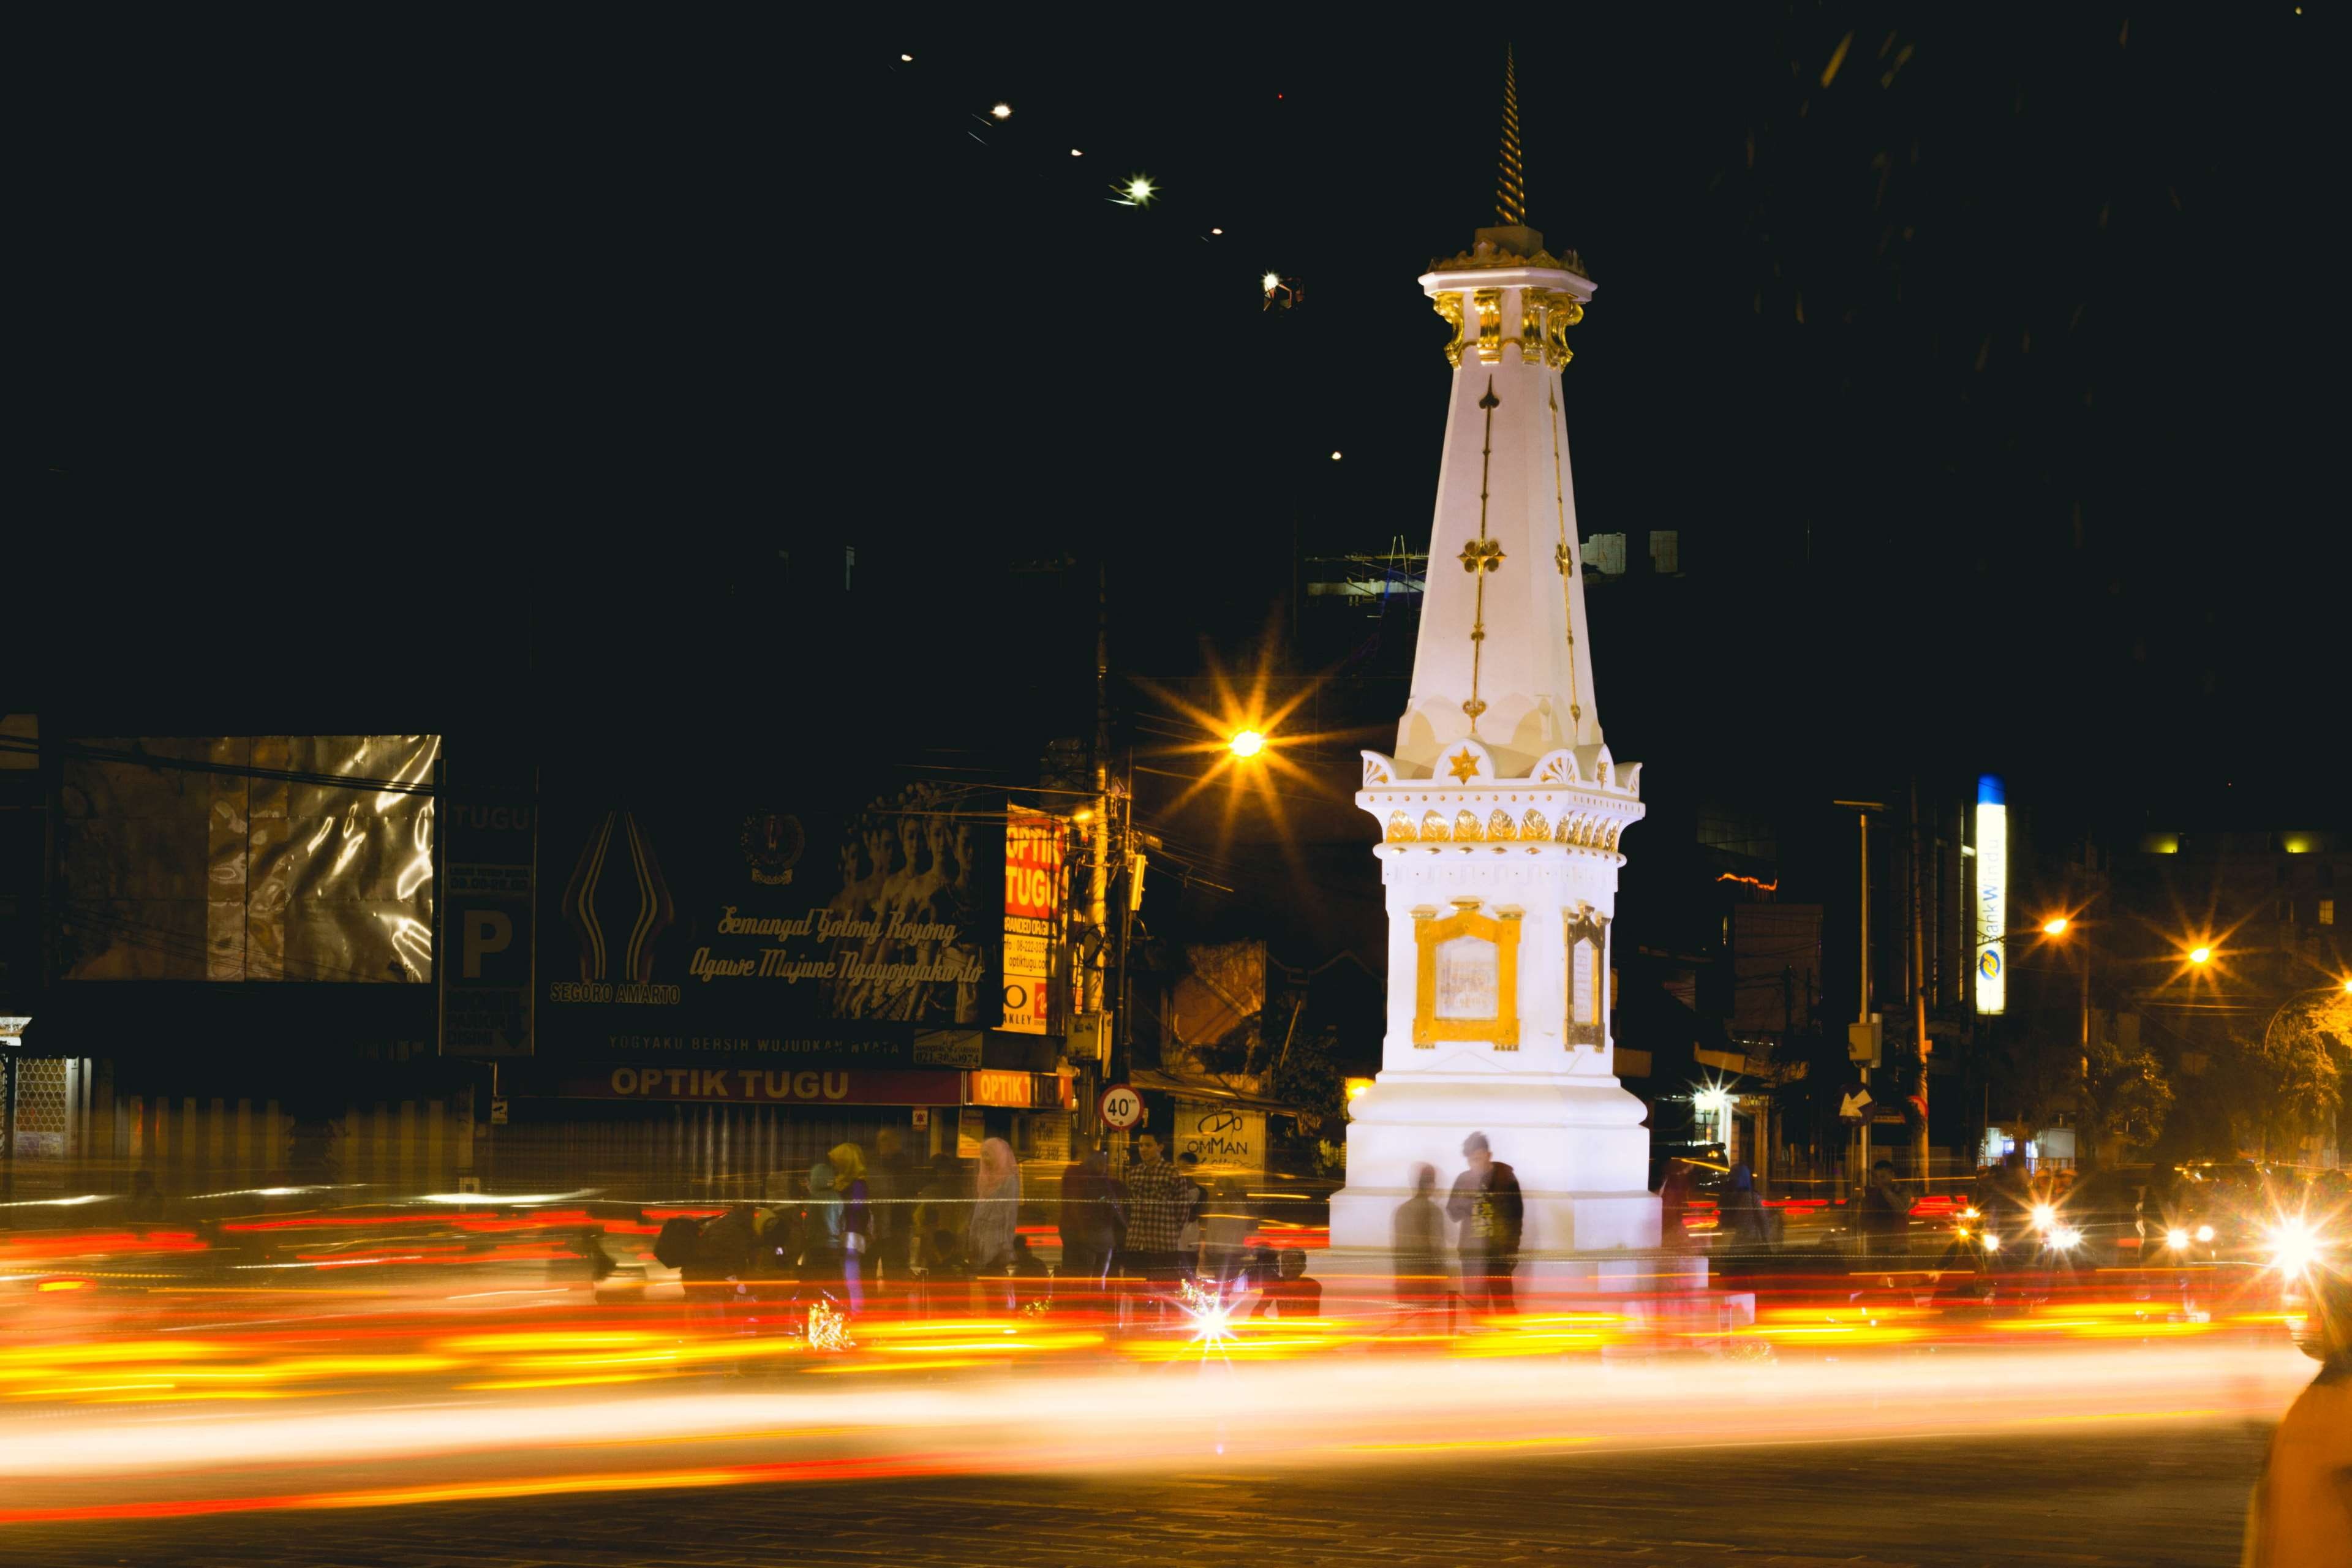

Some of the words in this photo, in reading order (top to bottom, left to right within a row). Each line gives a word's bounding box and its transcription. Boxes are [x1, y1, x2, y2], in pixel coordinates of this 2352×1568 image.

[453, 805, 529, 829] TUGU
[1006, 825, 1061, 864] OPTIK
[1006, 866, 1059, 909] TUGU
[717, 906, 813, 942] Semangat
[884, 911, 957, 947] Royong
[462, 910, 513, 978] P
[690, 947, 755, 982] Agawe
[759, 949, 836, 984] Majune
[1009, 956, 1050, 972] optiktugu.co
[551, 982, 612, 1003] SEGORO
[616, 984, 681, 1005] AMARTO
[1005, 1013, 1031, 1025] AKLEY
[691, 1037, 748, 1051] BERSIH
[611, 1067, 728, 1096] OPTIK
[738, 1070, 849, 1099] TUGU
[981, 1074, 1023, 1102] OPTIK
[1107, 1098, 1128, 1117] 40
